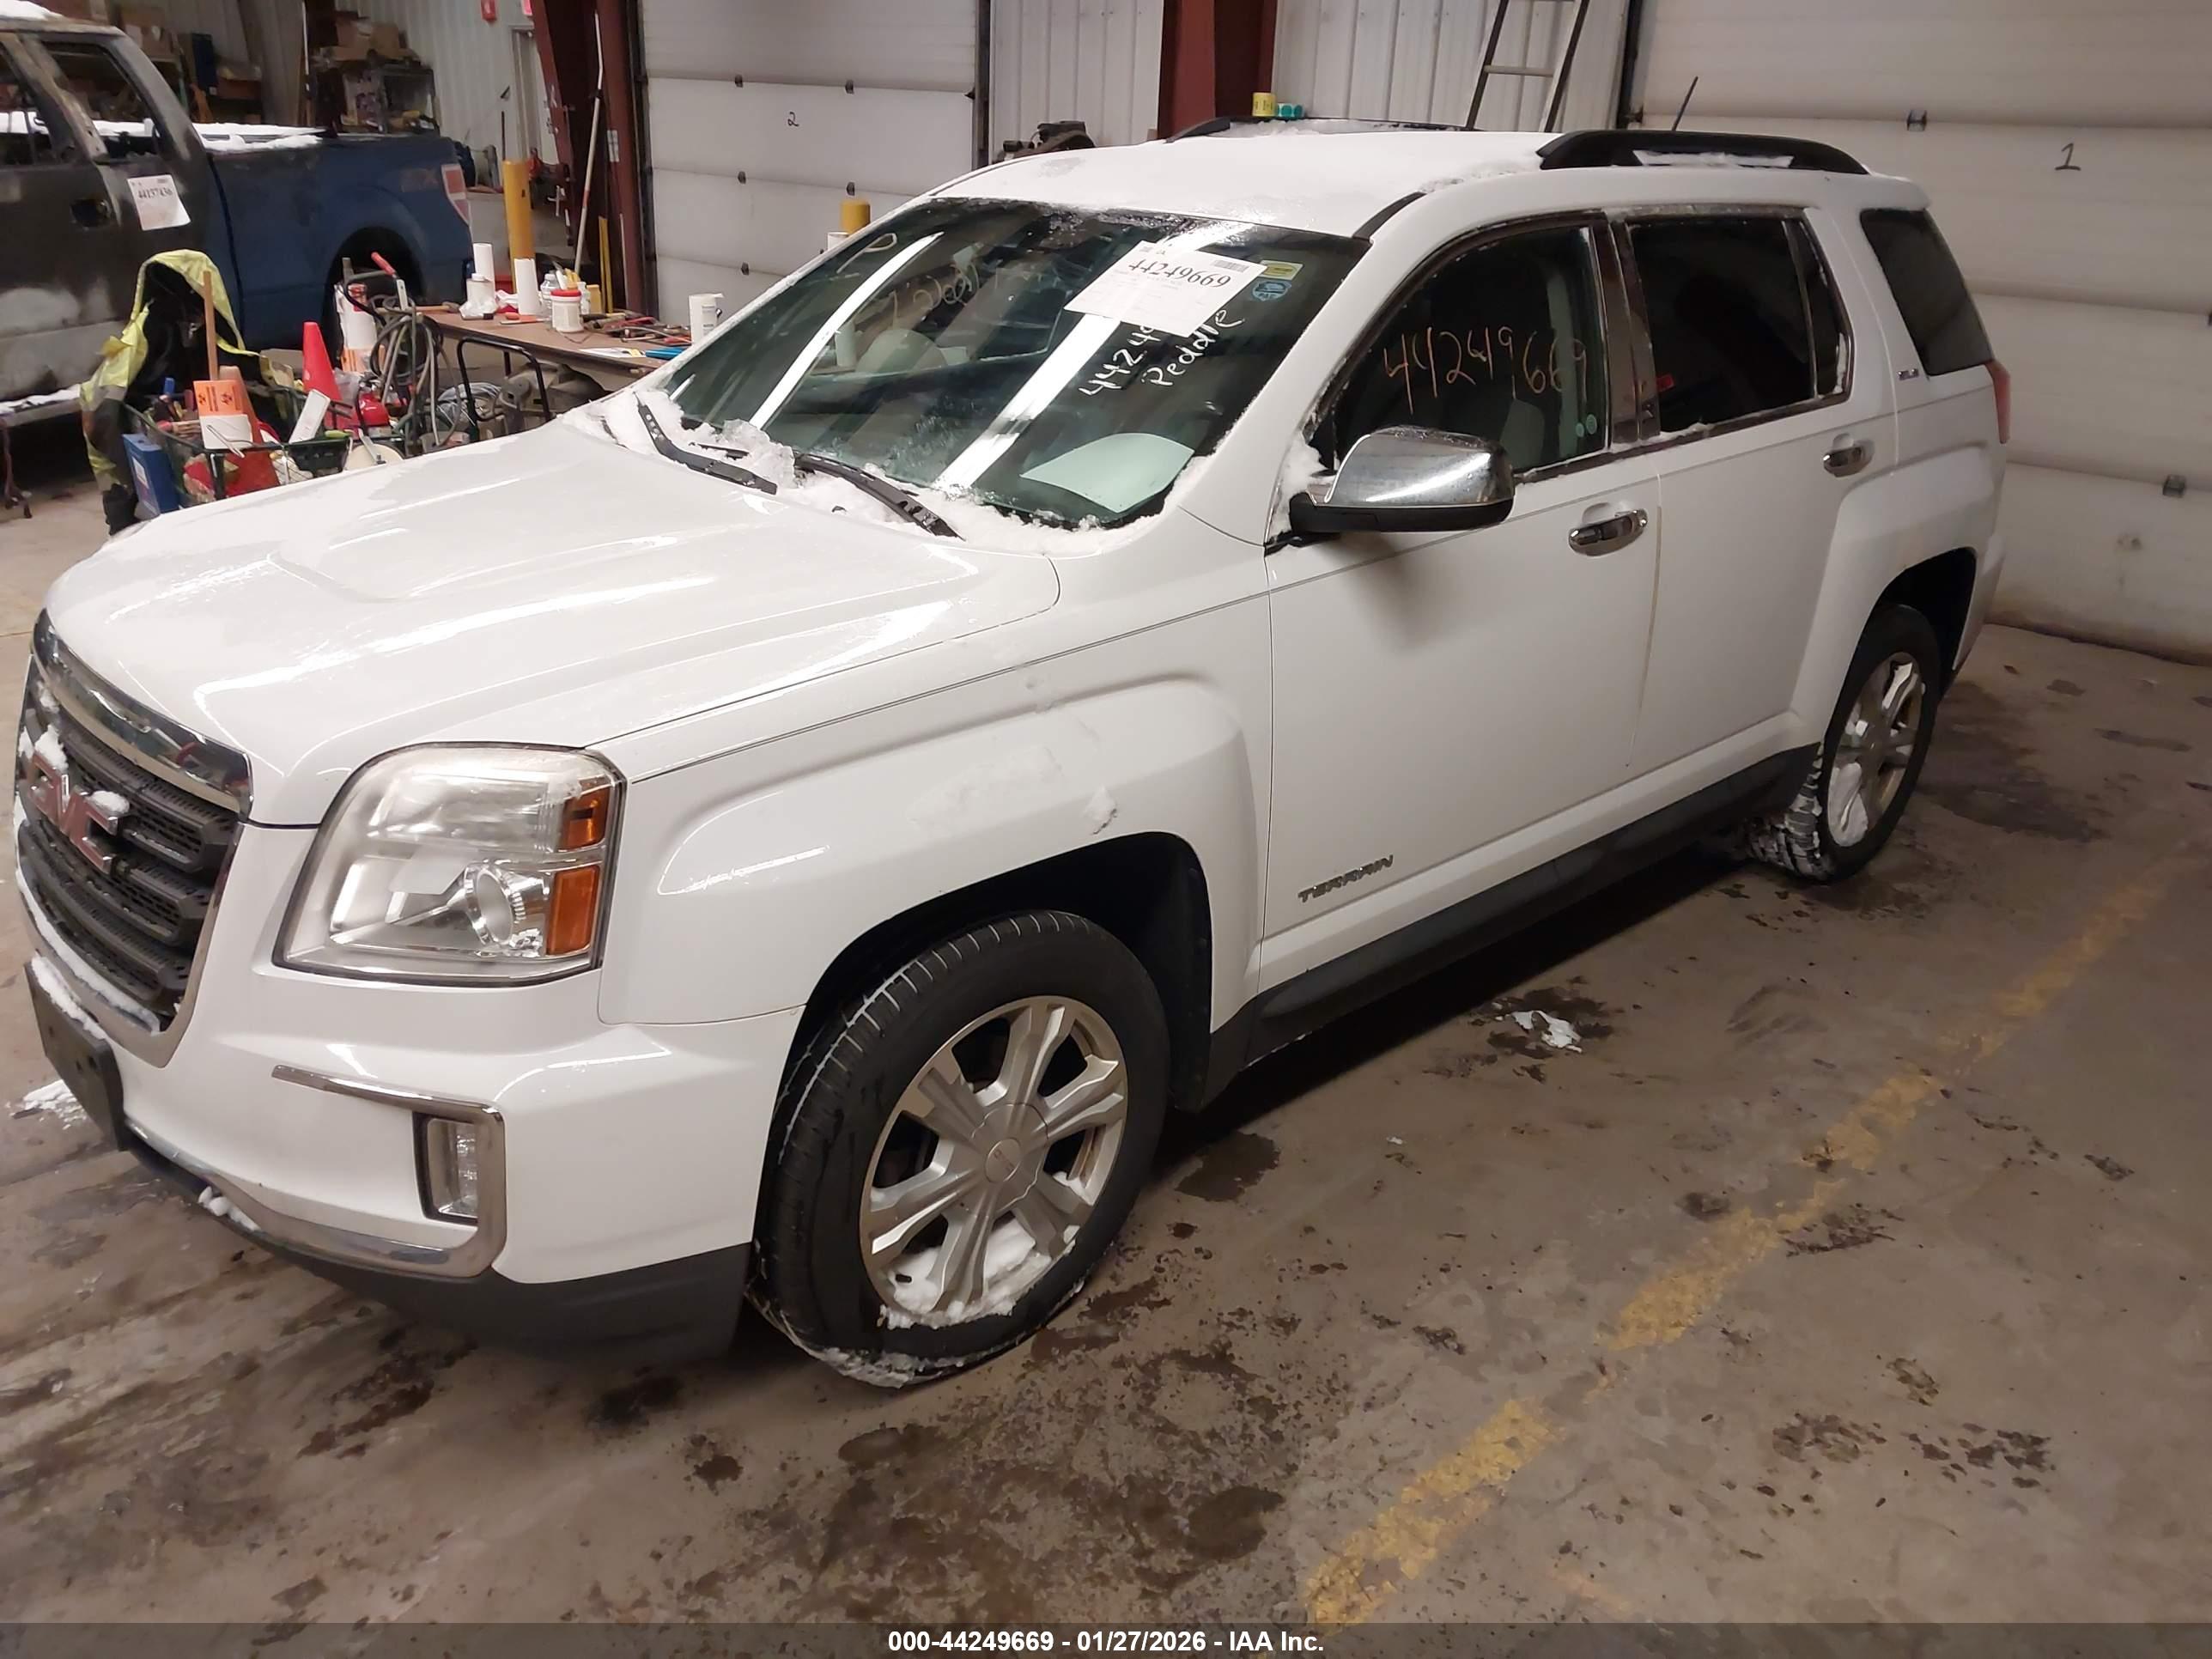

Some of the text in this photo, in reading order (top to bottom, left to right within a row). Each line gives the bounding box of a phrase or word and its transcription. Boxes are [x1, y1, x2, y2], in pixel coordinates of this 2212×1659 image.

[787, 111, 799, 127] 2
[2054, 143, 2081, 172] 1
[1127, 258, 1231, 288] 44249669
[1383, 326, 1588, 415] 44249669
[27, 750, 118, 874] GMC
[1297, 854, 1393, 902] TERRAIN
